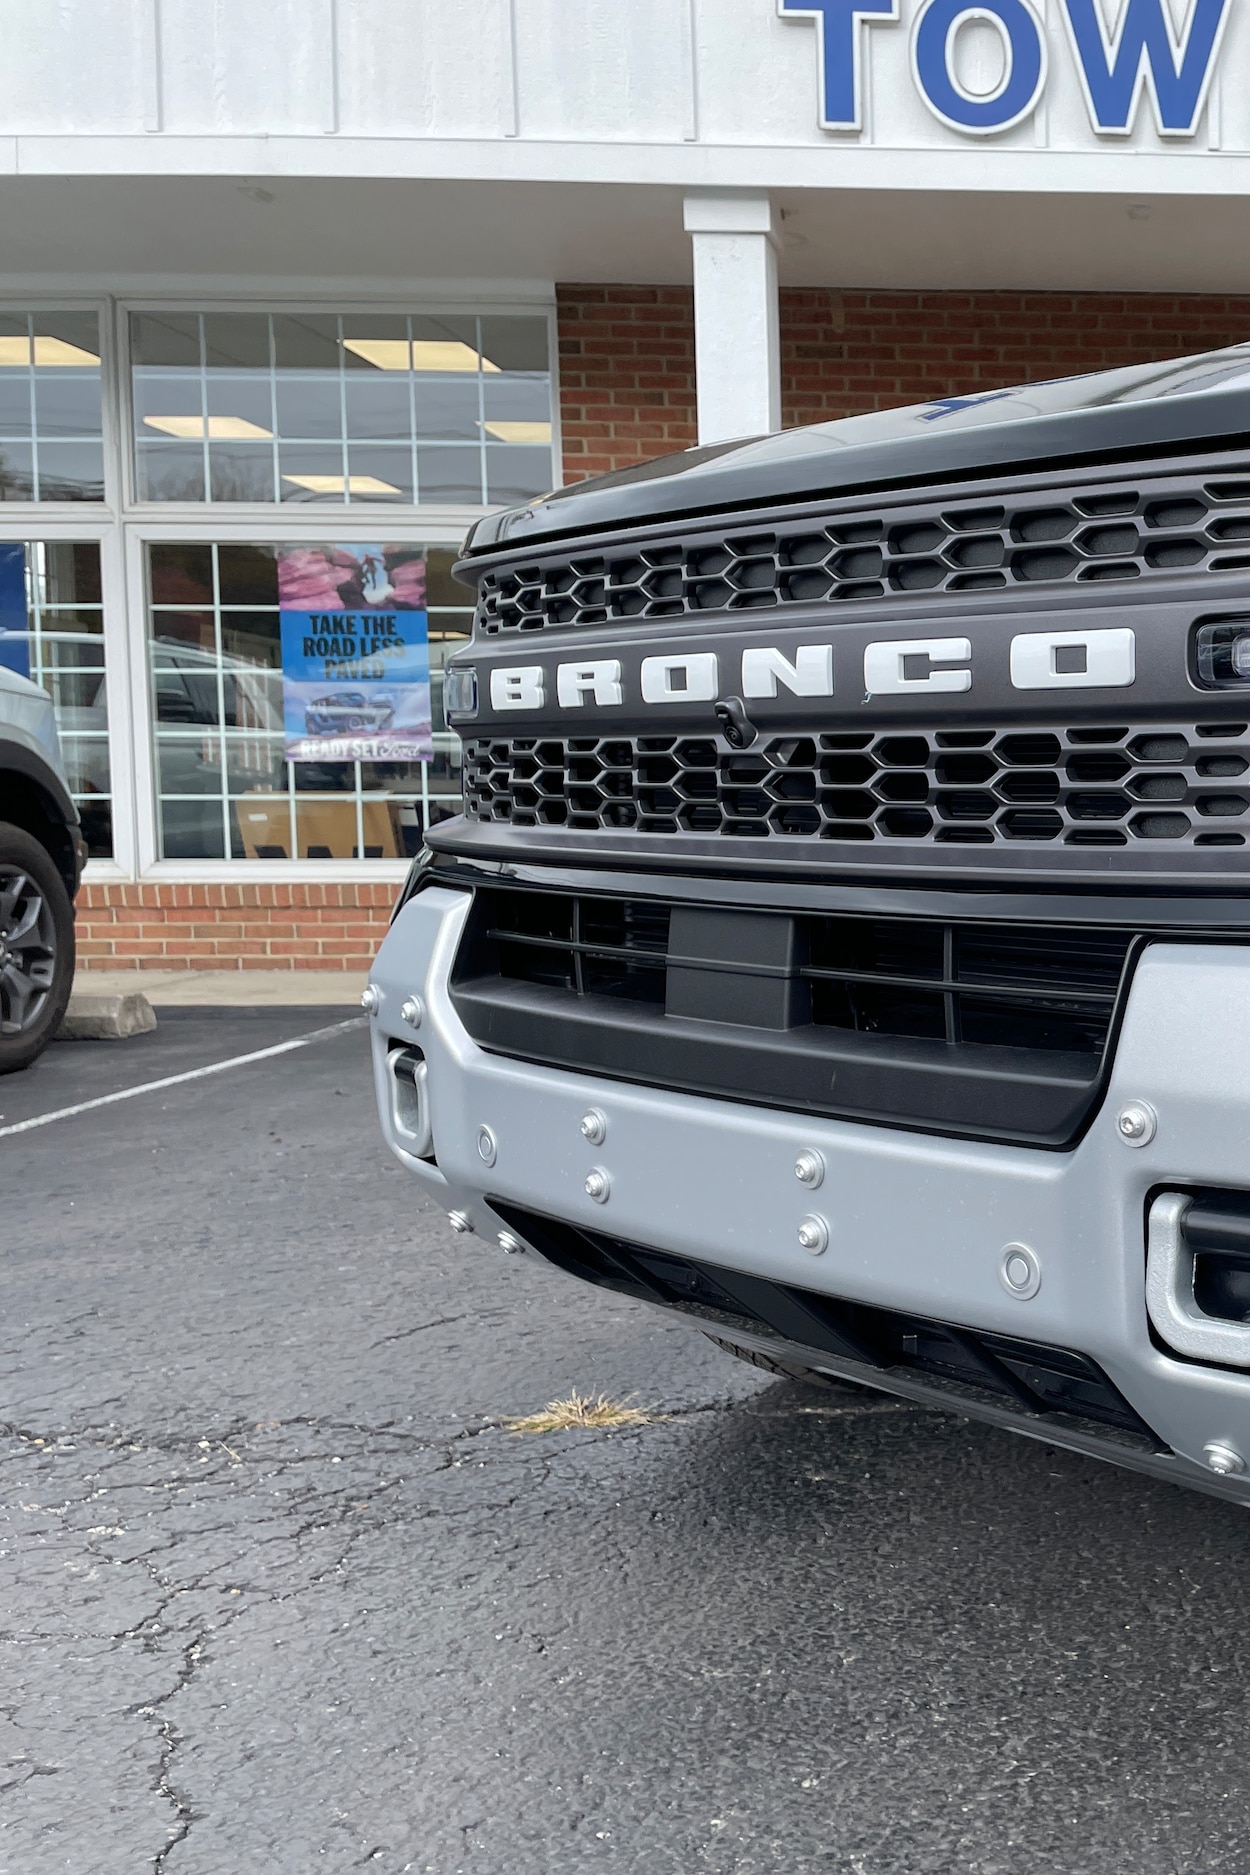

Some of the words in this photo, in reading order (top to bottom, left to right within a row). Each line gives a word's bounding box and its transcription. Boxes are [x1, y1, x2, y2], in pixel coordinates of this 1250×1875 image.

[310, 615, 356, 635] TAKE
[361, 615, 397, 635] THE
[303, 637, 356, 657] ROAD
[360, 638, 406, 657] LESS
[325, 659, 385, 679] PAVED
[490, 628, 1136, 711] BRONCO
[301, 740, 350, 757] READY
[352, 740, 379, 756] SET
